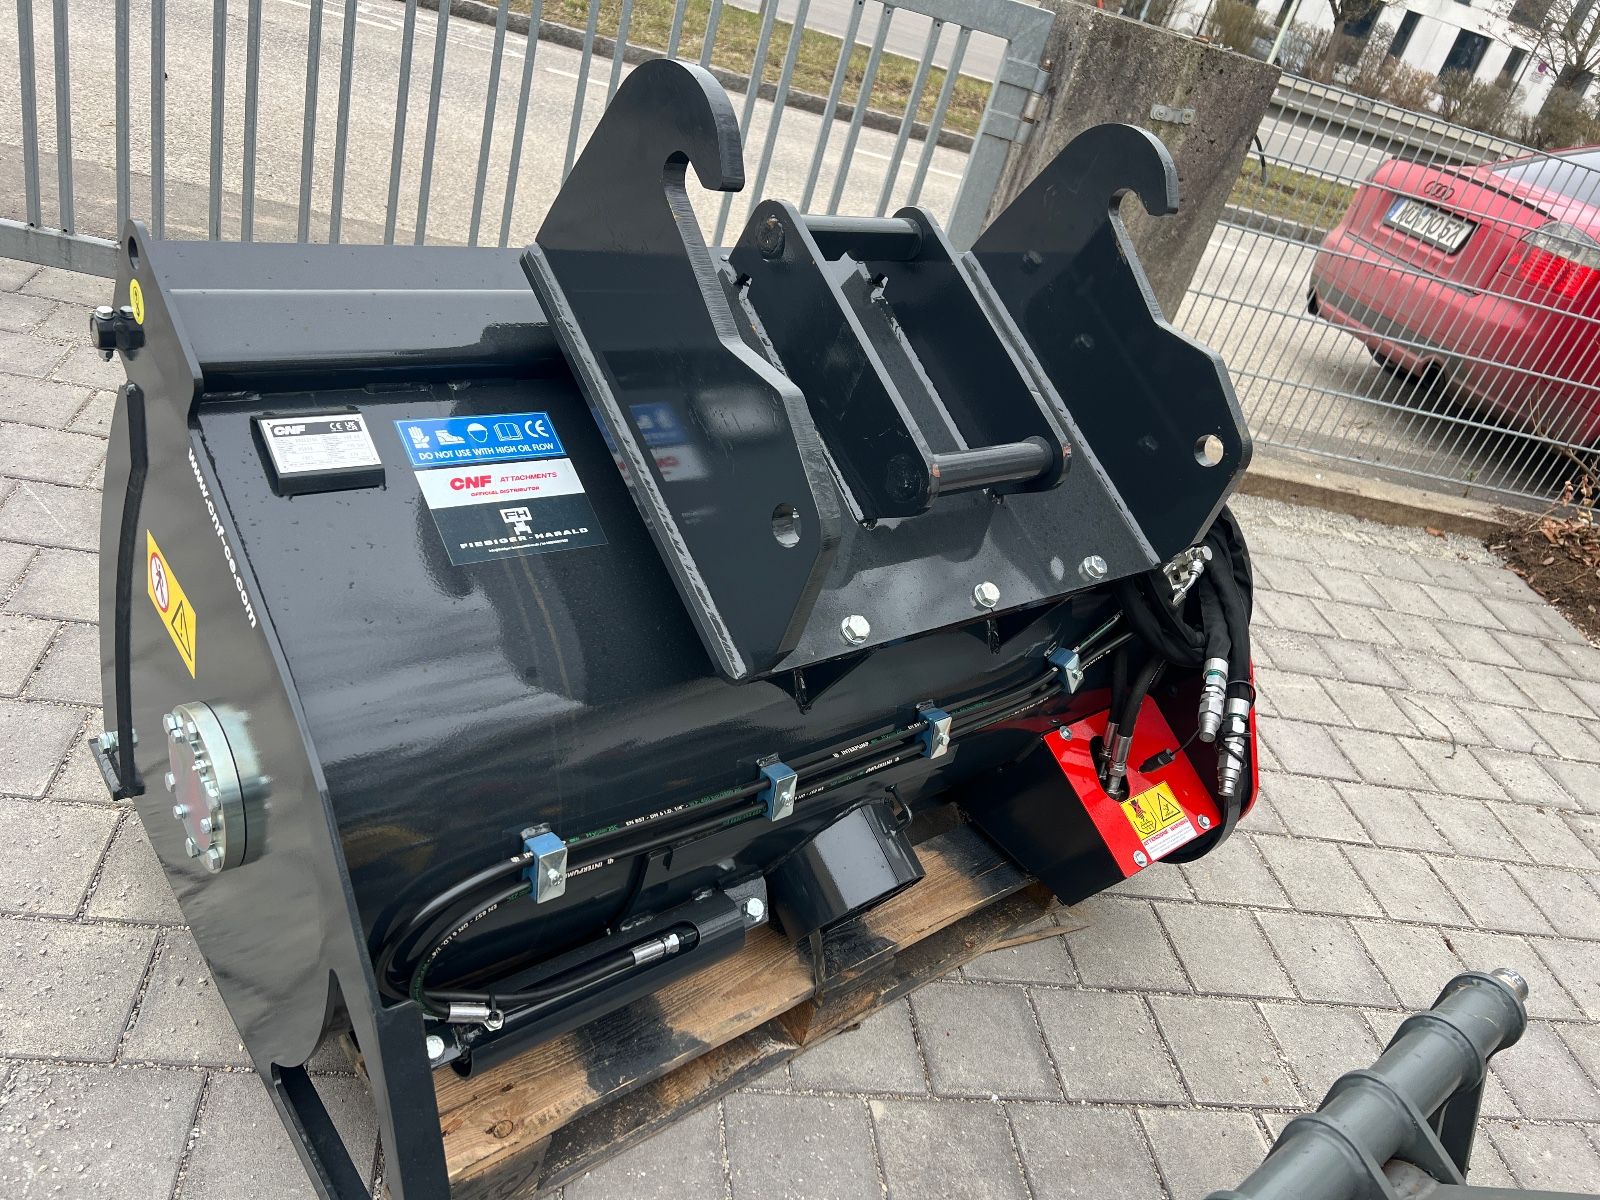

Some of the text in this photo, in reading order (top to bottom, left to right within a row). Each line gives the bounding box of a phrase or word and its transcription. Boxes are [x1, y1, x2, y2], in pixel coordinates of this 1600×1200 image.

[274, 425, 306, 435] CNF
[419, 442, 555, 461] DO NOT USE WITH HIGH OIL FLOW
[449, 471, 558, 491] CNF ATTACHMENTS
[470, 486, 540, 497] OFFICIAL DISTRIBUTOR
[503, 509, 529, 520] FH
[188, 447, 257, 629] www.cnf-ce.com
